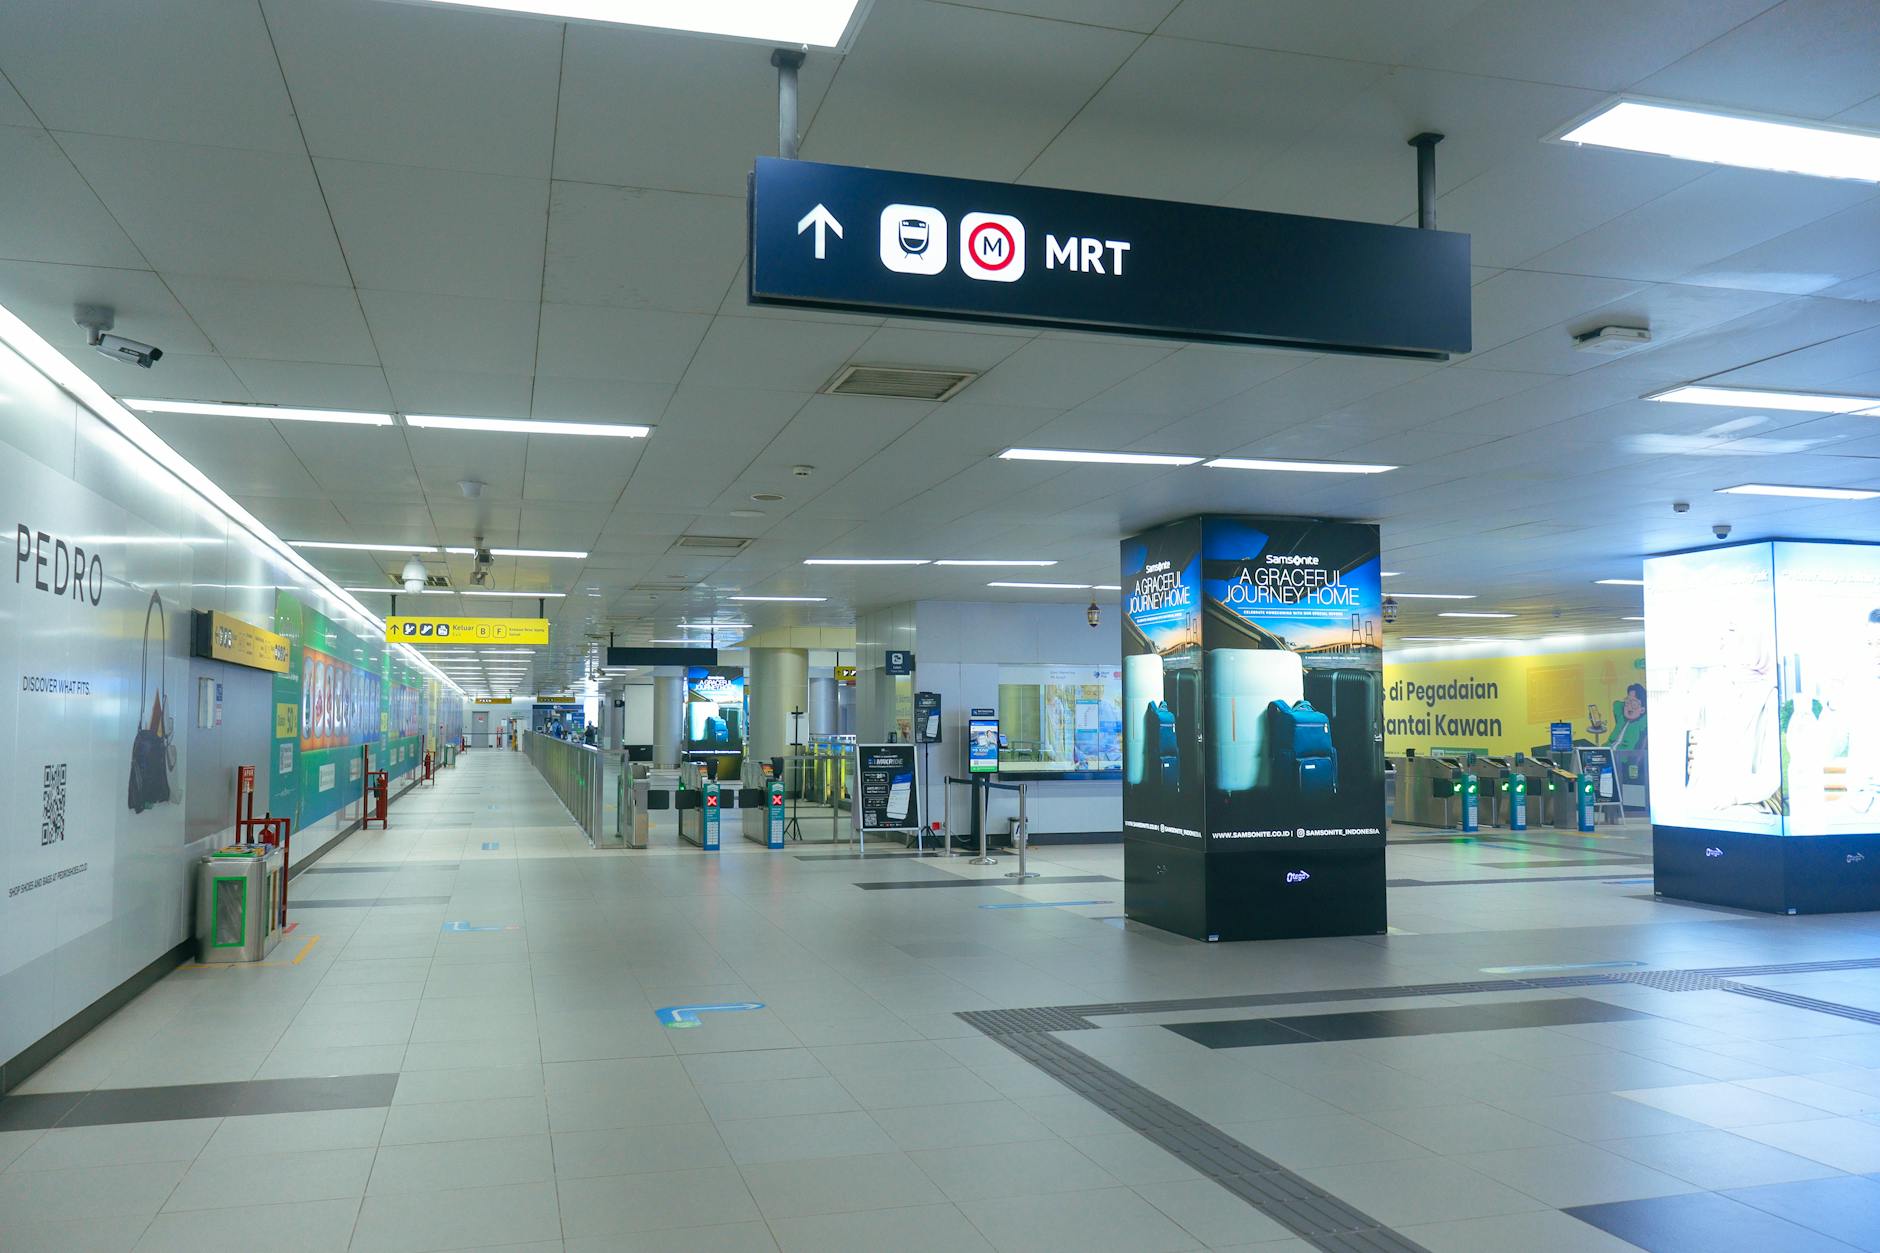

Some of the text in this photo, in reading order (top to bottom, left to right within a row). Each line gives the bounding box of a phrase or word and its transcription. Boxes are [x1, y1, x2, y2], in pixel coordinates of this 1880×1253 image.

[1046, 234, 1131, 276] MRT
[16, 523, 103, 607] PEDRO
[1265, 554, 1319, 566] Samsonite
[1135, 571, 1184, 596] A GRACEFUL
[1239, 567, 1347, 588] A GRACEFUL
[1129, 586, 1191, 614] JOURNEY HOME
[1225, 584, 1361, 606] JOURNEY HOME
[22, 675, 58, 693] DISCOVER
[58, 680, 77, 695] WHAT
[1389, 680, 1403, 701] di
[1406, 677, 1498, 708] Pegadaian
[1435, 714, 1502, 737] Kawan
[1306, 828, 1380, 837] SAMSONITE_INDONESIA
